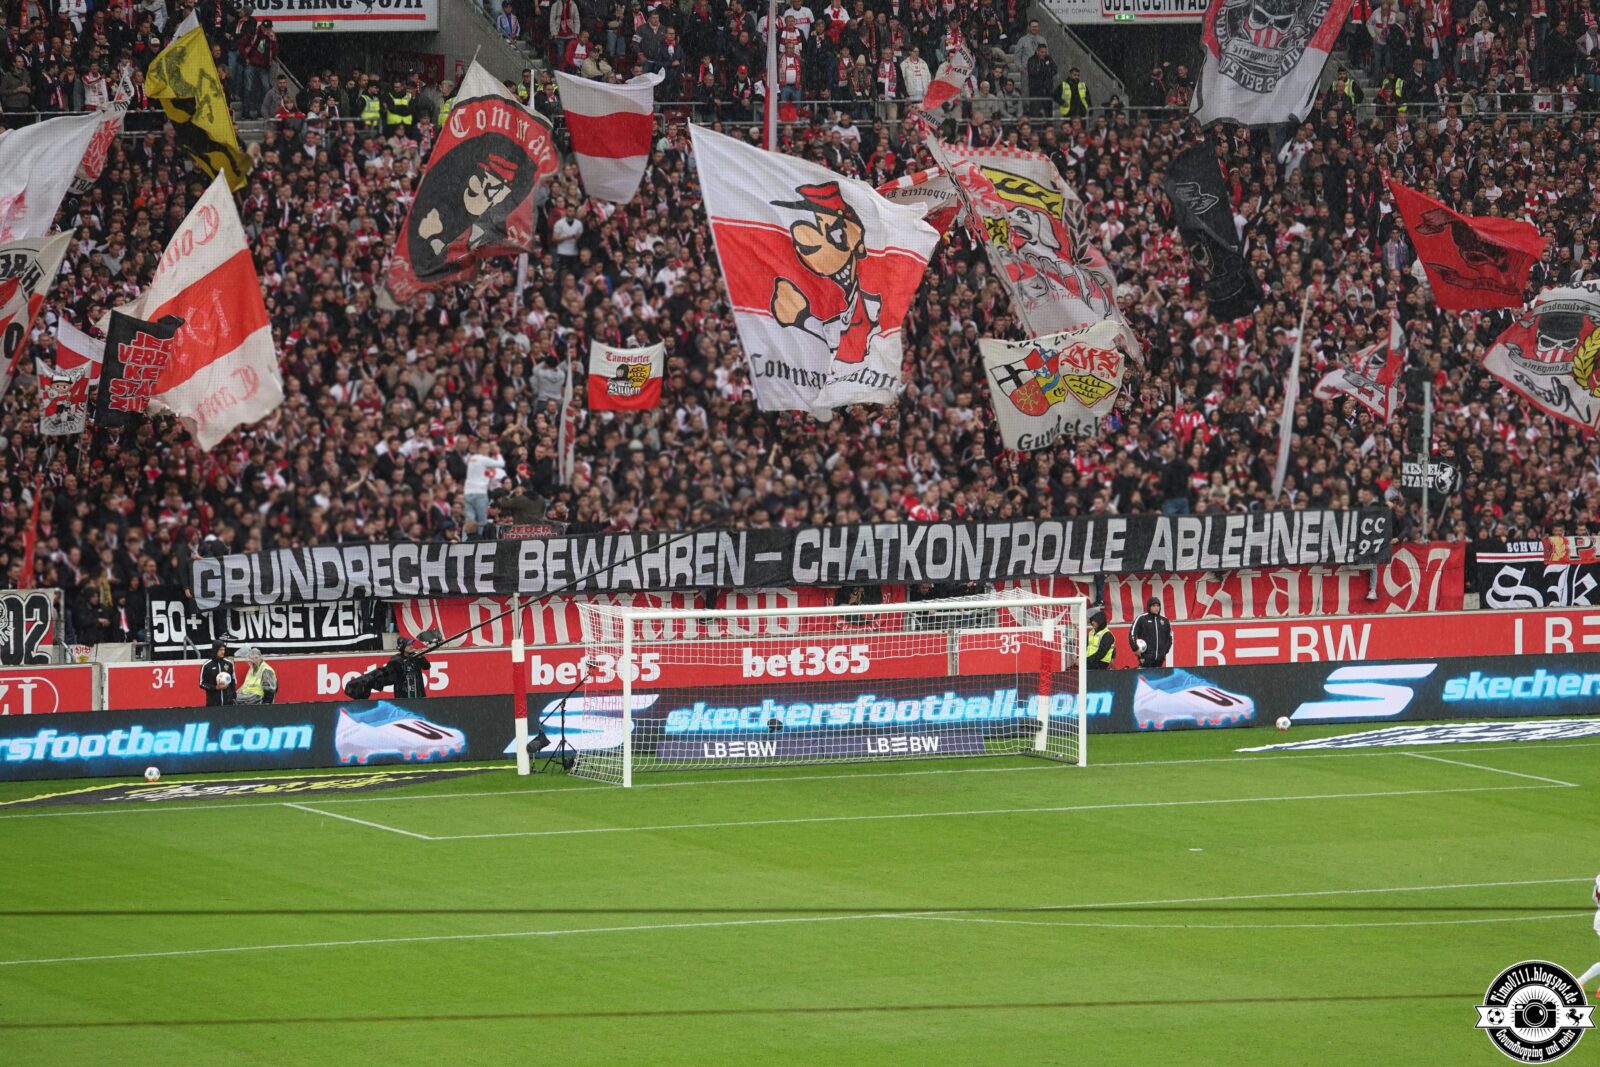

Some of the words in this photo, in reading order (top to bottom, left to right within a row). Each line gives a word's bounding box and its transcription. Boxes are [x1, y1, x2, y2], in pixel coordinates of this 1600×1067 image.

[1360, 516, 1386, 535] CC
[192, 542, 497, 611] GRUNDRECHTE
[518, 530, 747, 593] BEWAHREN
[792, 517, 1127, 584] CHATKONTROLLE
[1143, 508, 1359, 571] ABLEHNEN!
[1358, 537, 1385, 555] 97
[1382, 547, 1451, 614] 97
[742, 644, 870, 678] bet365
[1000, 634, 1020, 654] 35
[152, 667, 175, 689] 34
[531, 652, 661, 686] bet365
[1442, 668, 1600, 702] skecher
[665, 689, 1114, 732] skechersfootball.com
